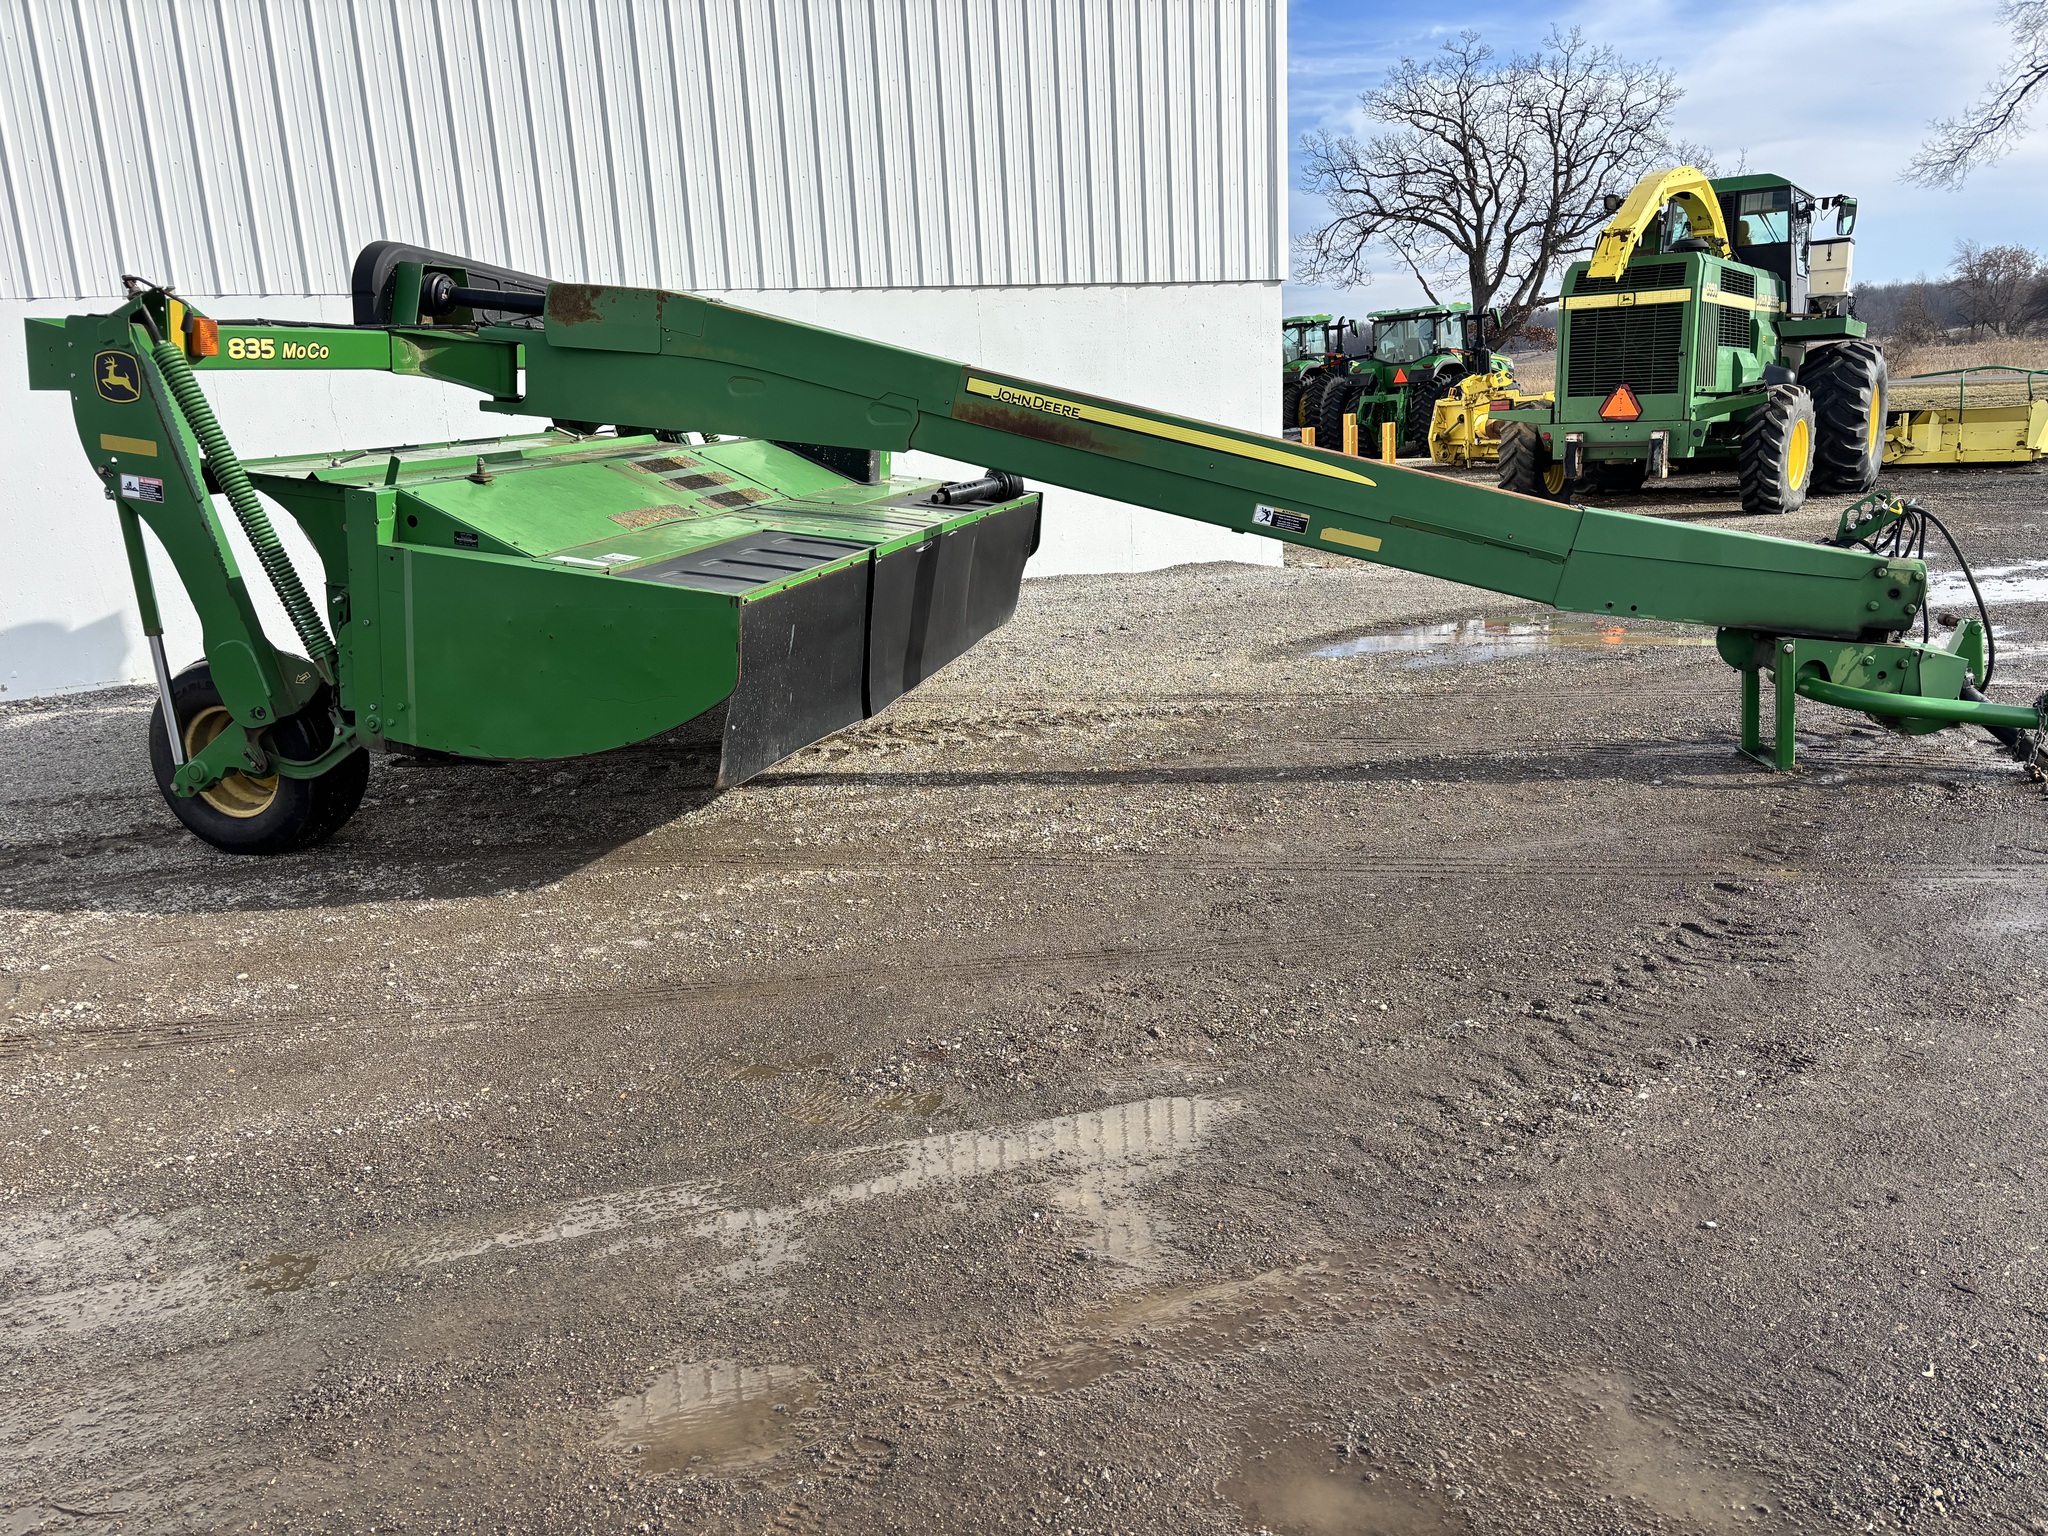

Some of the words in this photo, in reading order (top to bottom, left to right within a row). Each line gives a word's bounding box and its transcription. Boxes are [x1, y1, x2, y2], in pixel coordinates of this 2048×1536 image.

[228, 337, 275, 360] 835
[282, 342, 329, 360] MoCo
[993, 388, 1032, 408] JOHN
[1033, 396, 1081, 418] DEERE
